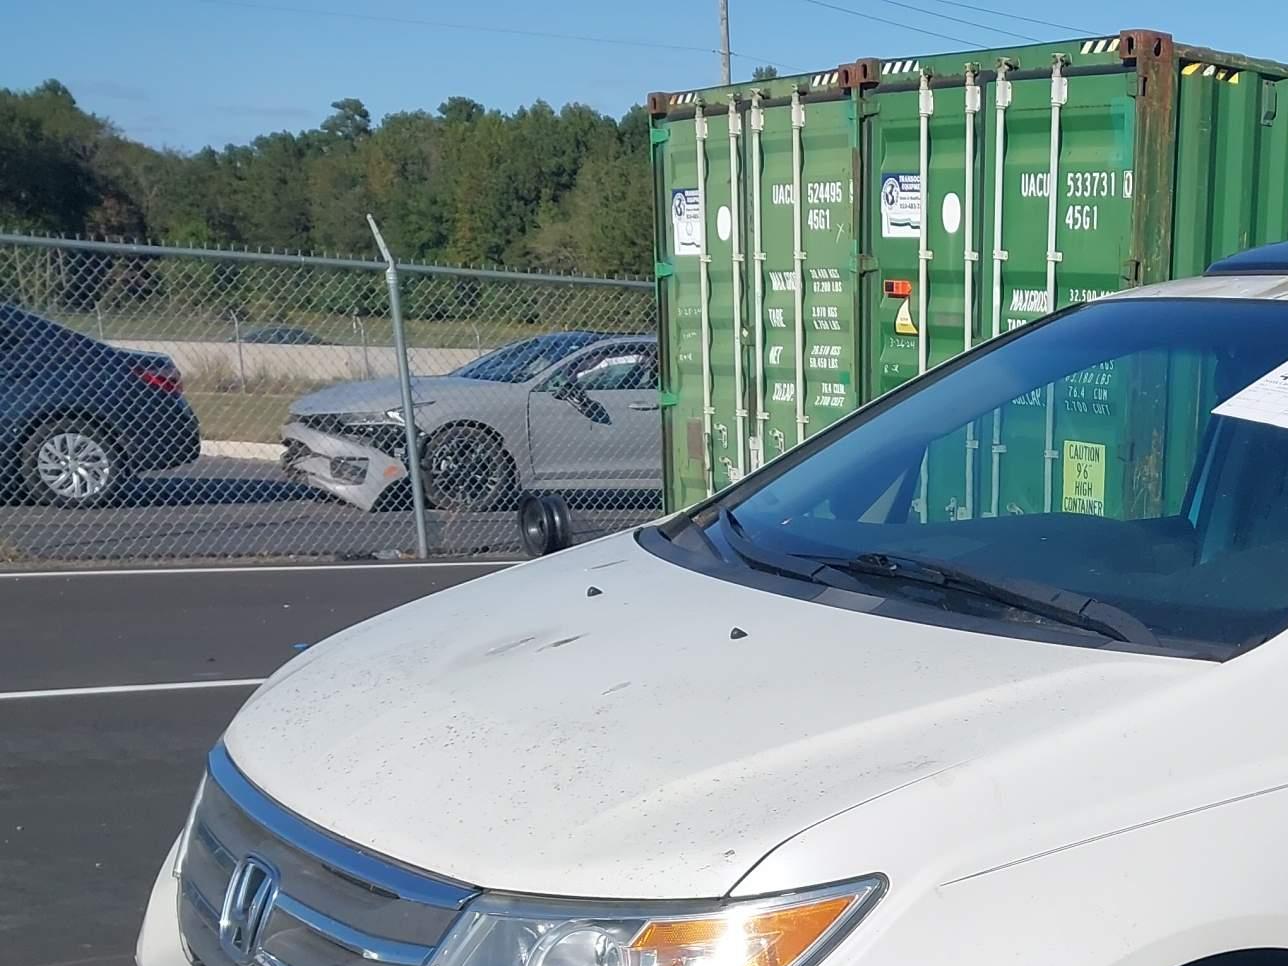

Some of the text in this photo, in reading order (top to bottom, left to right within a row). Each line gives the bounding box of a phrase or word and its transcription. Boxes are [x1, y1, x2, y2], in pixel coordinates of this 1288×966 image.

[807, 181, 842, 204] 524495
[1021, 172, 1050, 197] UACU
[1066, 172, 1116, 197] 533731
[807, 208, 830, 230] 45G1
[1065, 205, 1098, 230] 45G1
[769, 345, 784, 365] NET
[1094, 373, 1112, 385] LBS
[1068, 386, 1086, 399] 76.4
[1065, 400, 1088, 413] 2.700
[1069, 443, 1100, 463] CAUTION
[1074, 481, 1093, 498] HIGH
[1063, 496, 1103, 516] CONTAINER
